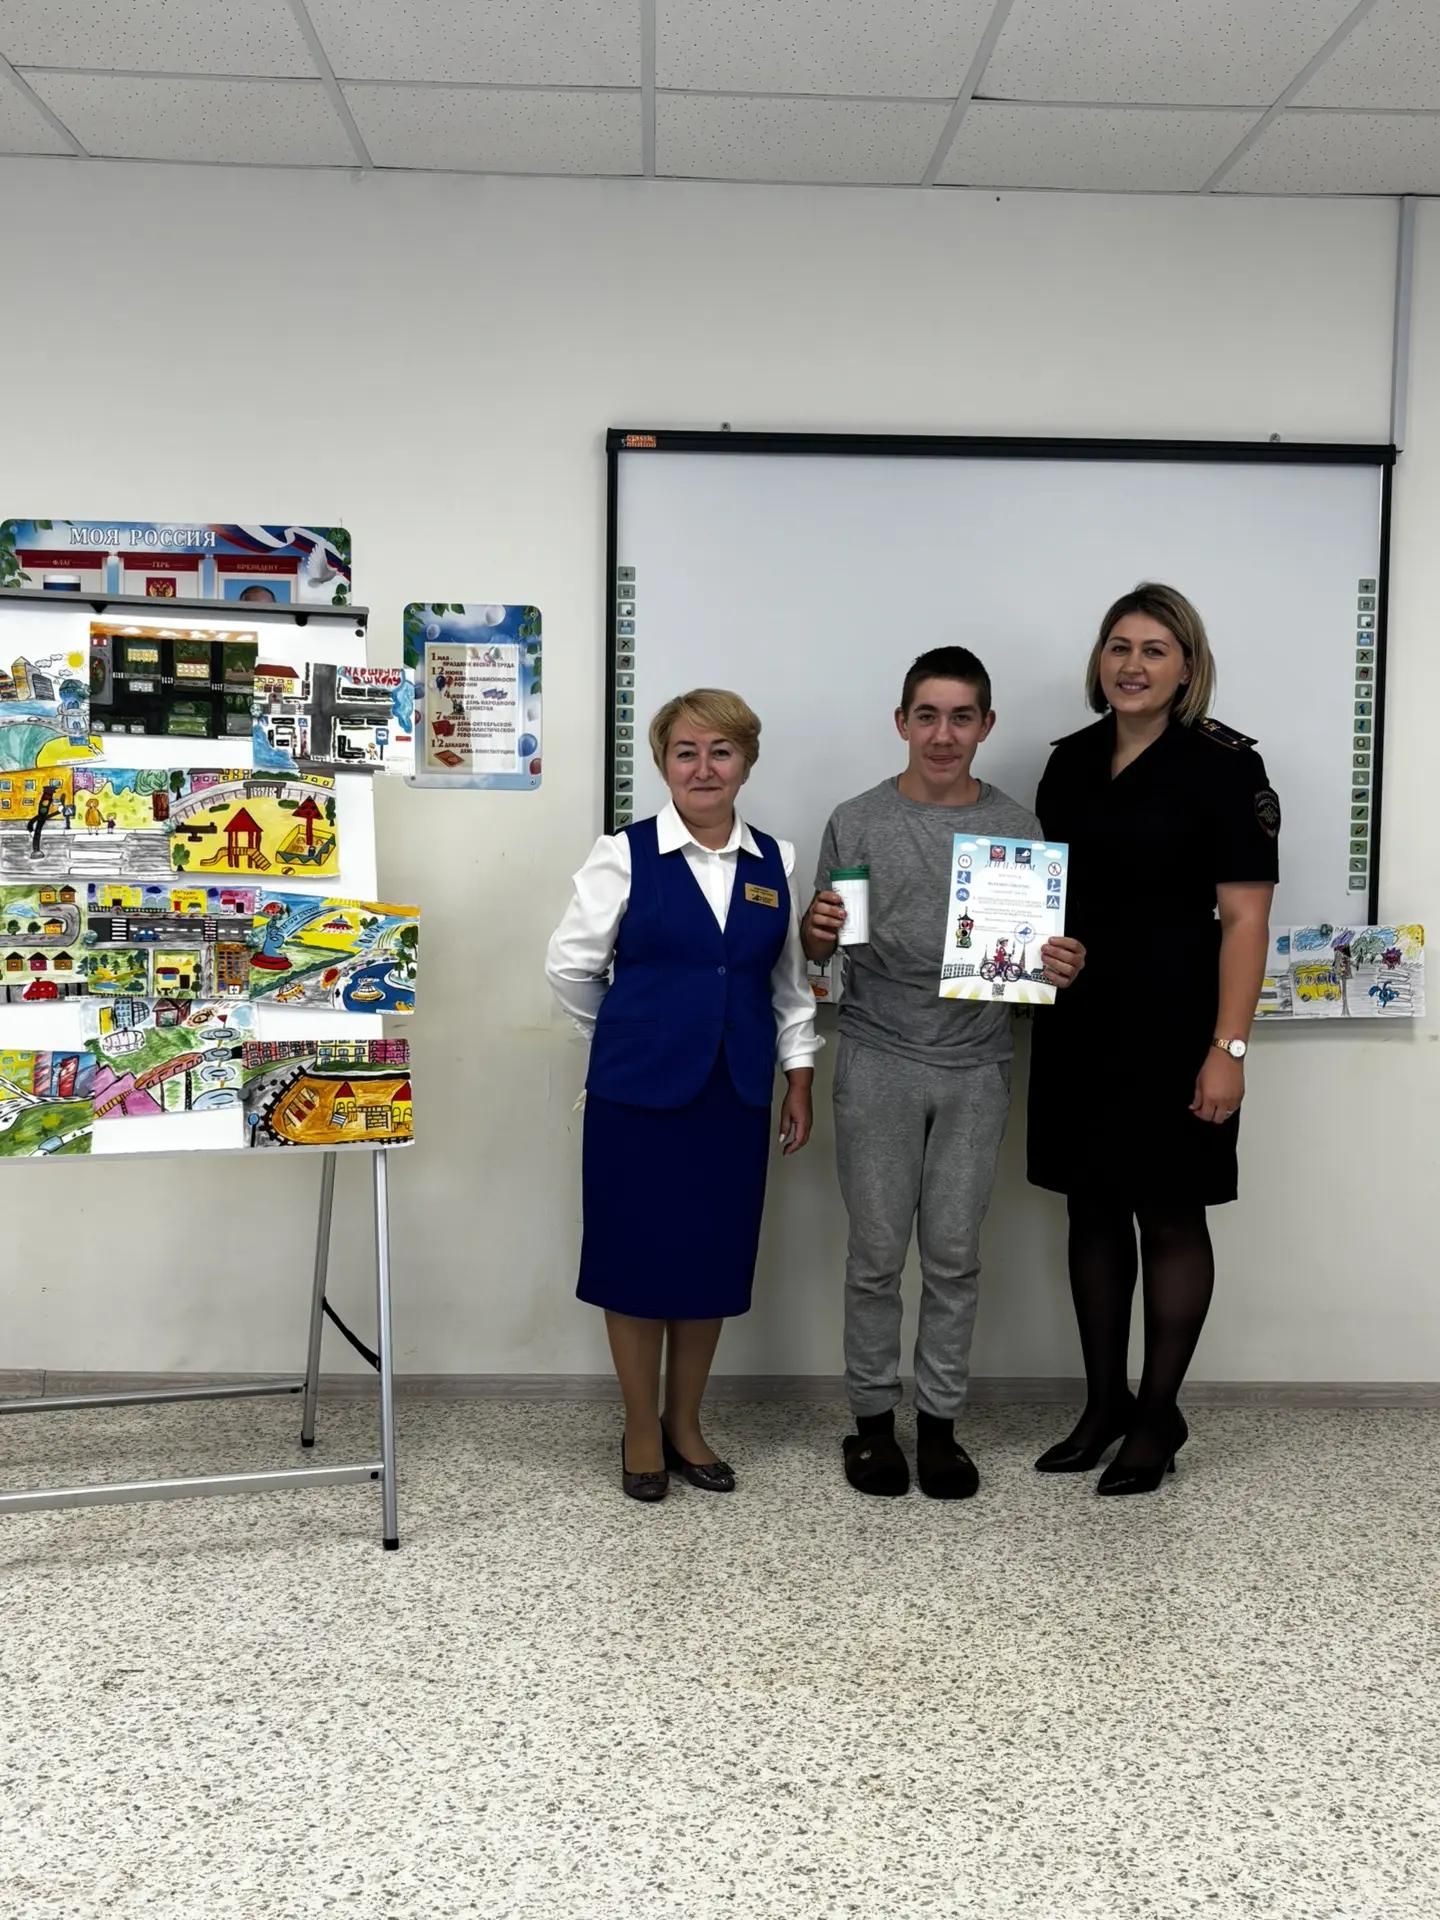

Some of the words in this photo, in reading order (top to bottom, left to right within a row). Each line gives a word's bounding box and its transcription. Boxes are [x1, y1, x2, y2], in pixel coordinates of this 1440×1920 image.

[69, 527, 120, 546] МОЯ
[129, 528, 216, 548] РОССИЯ
[236, 563, 278, 571] ПРЕЗИДЕНТ
[431, 652, 436, 660] 1
[431, 666, 445, 675] 12
[435, 711, 442, 720] 7
[431, 739, 444, 748] 12
